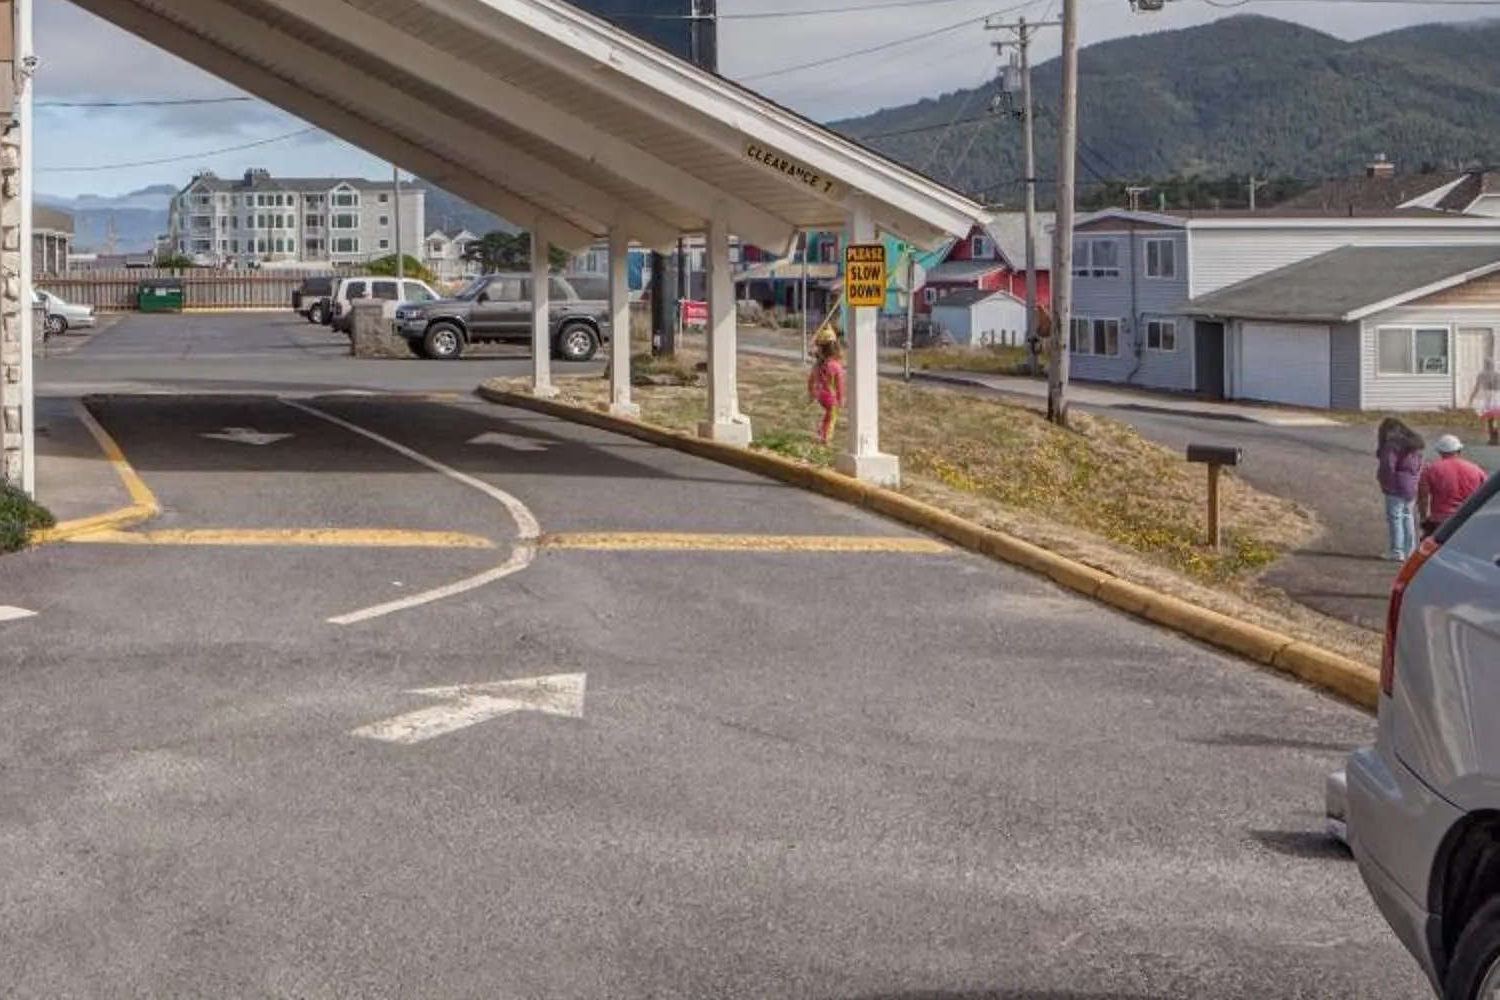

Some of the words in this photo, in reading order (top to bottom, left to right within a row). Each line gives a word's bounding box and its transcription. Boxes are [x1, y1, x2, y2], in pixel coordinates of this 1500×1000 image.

[747, 145, 820, 187] CLEARANCE
[848, 247, 882, 260] PLEASE
[851, 265, 881, 281] SLOW
[850, 284, 881, 298] DOWN
